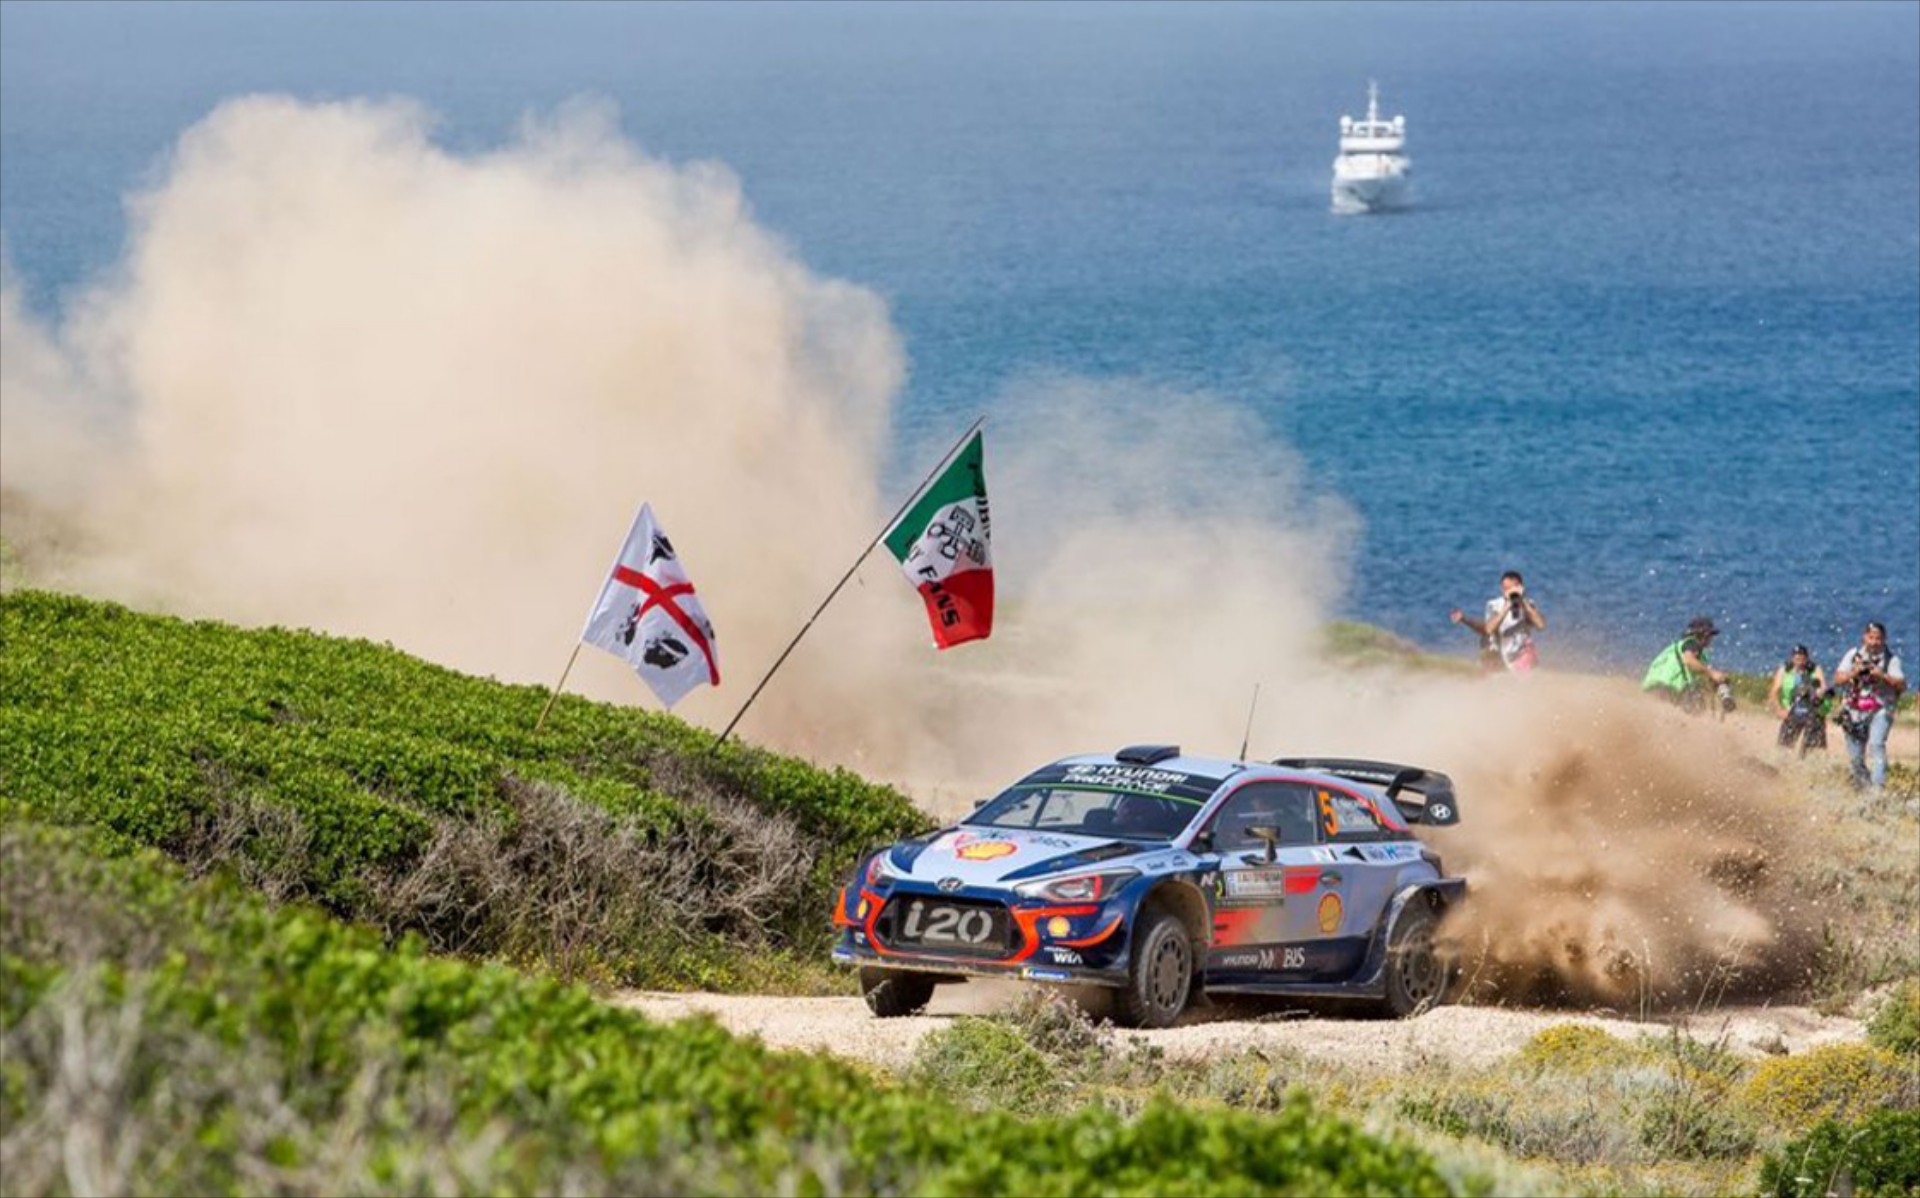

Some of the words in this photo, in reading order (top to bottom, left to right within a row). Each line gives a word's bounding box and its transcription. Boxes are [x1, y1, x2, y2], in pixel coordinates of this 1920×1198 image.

[918, 565, 960, 628] FANS
[1317, 790, 1339, 836] 5
[903, 900, 993, 944] i20
